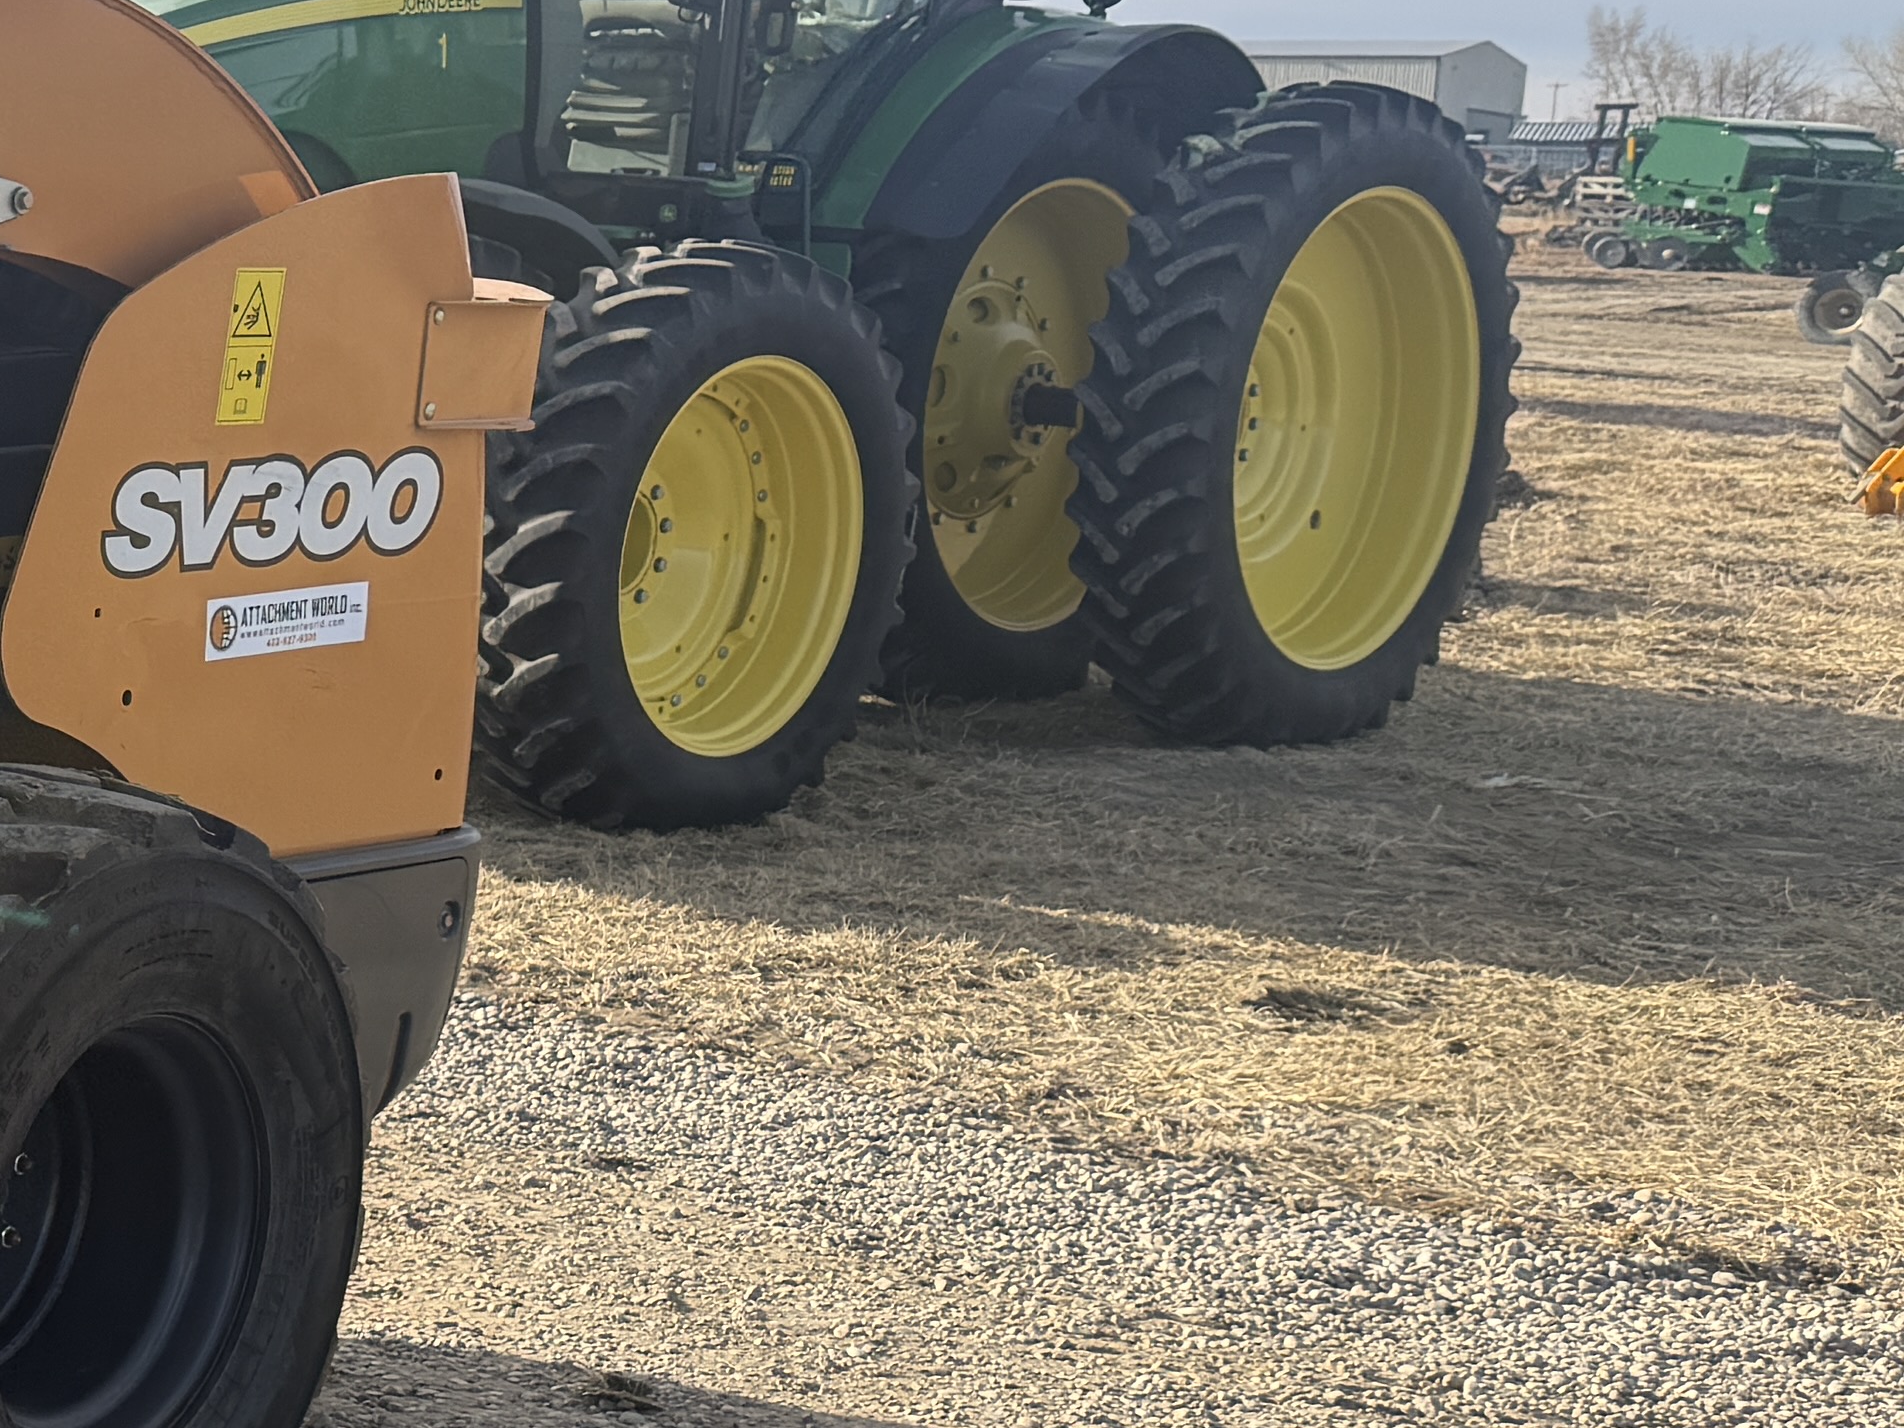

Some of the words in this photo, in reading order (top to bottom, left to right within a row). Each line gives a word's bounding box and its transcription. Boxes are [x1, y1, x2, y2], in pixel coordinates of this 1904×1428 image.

[101, 446, 443, 578] SV300
[241, 599, 308, 628] ATTACHMENT
[311, 595, 348, 618] WORLD
